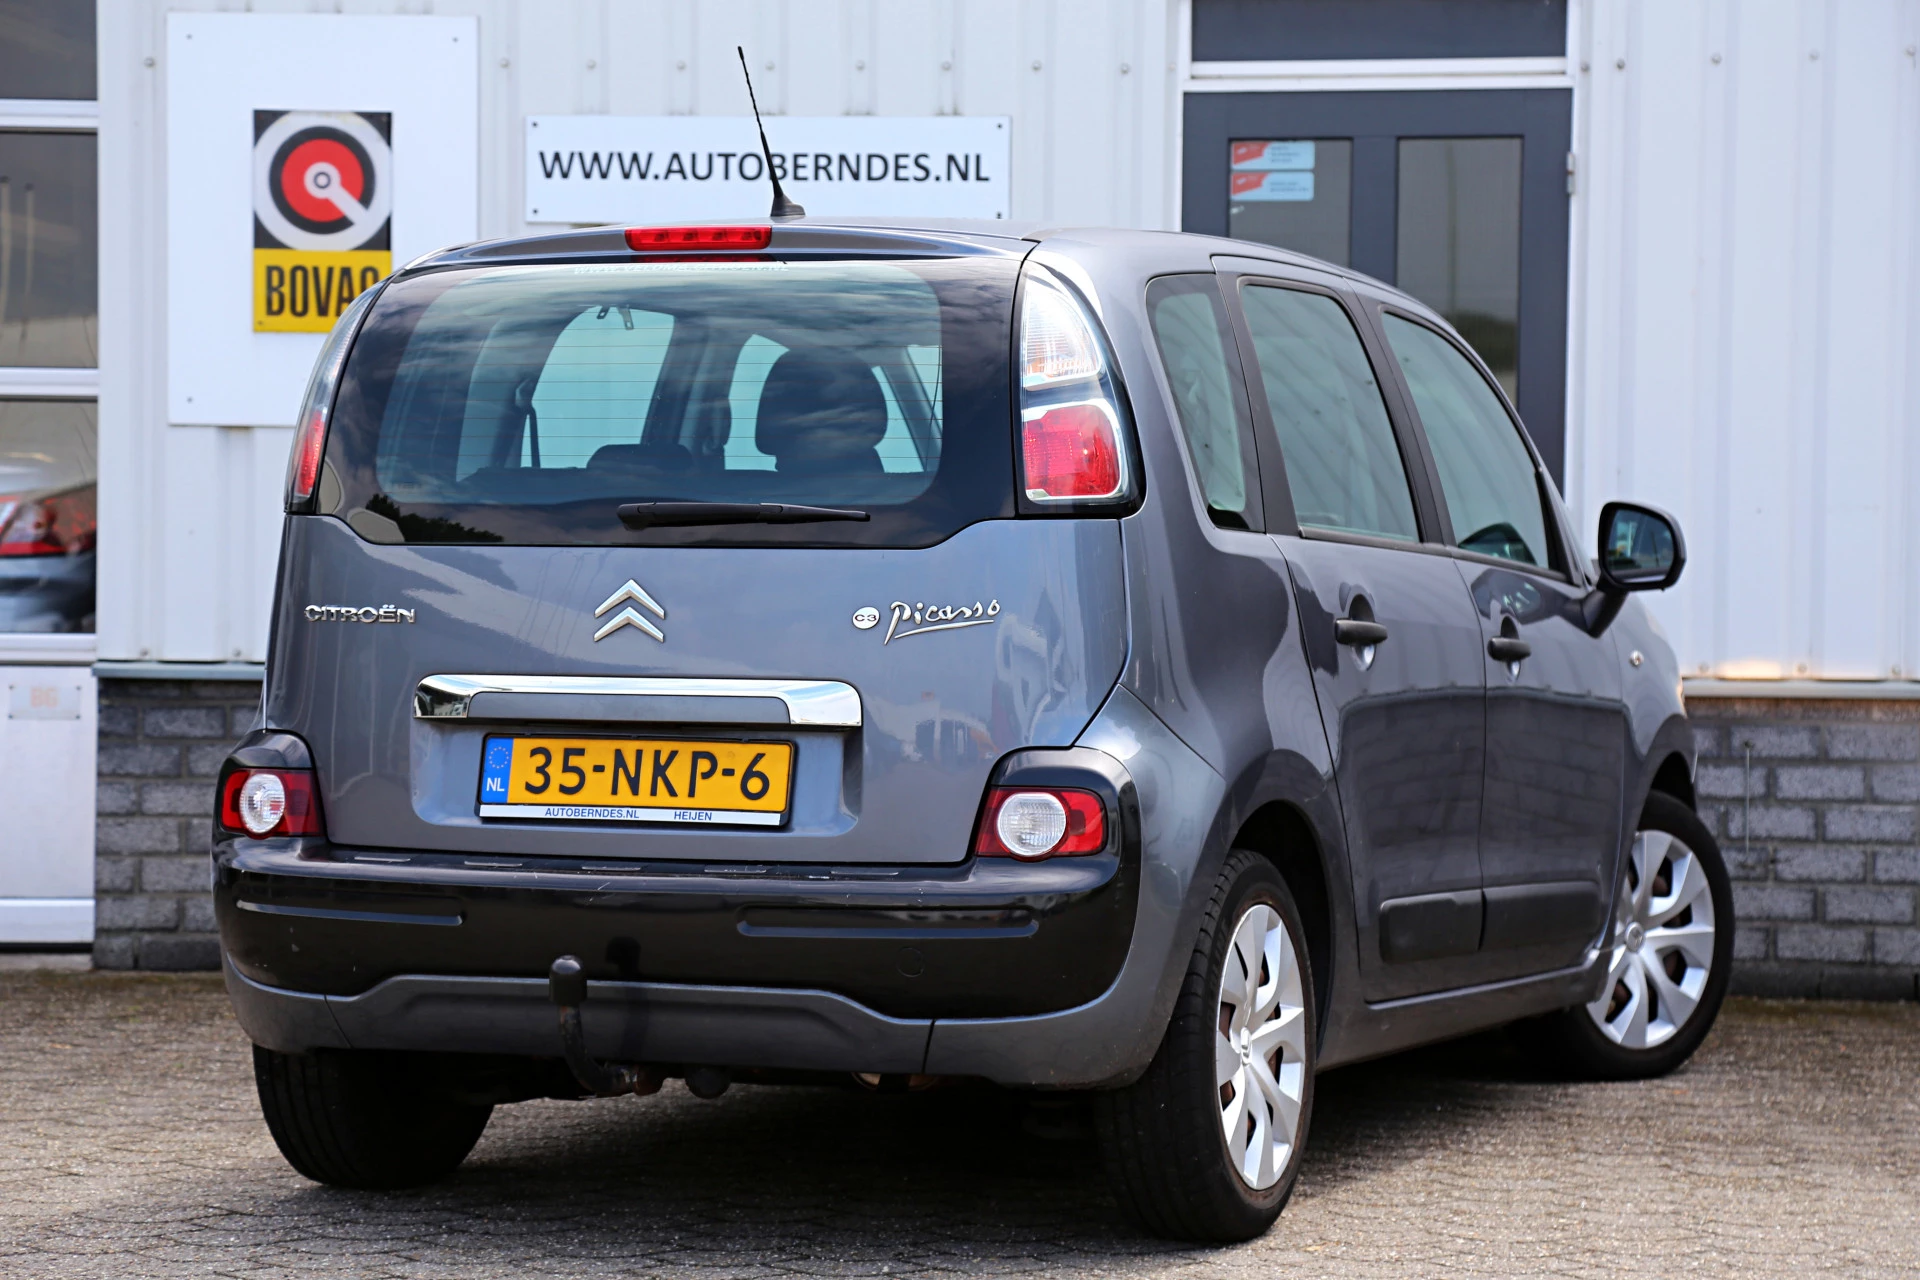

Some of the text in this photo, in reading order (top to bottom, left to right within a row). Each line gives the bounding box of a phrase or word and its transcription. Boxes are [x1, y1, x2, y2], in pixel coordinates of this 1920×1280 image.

[539, 151, 990, 182] WWW.AUTOBERNDES.NL
[304, 604, 415, 623] CITROËN
[883, 599, 1001, 645] Picasso
[485, 777, 505, 793] NL
[524, 746, 771, 801] 35-NKP-6
[545, 807, 713, 822] AUTOBERNDES.NL HEIJEN
